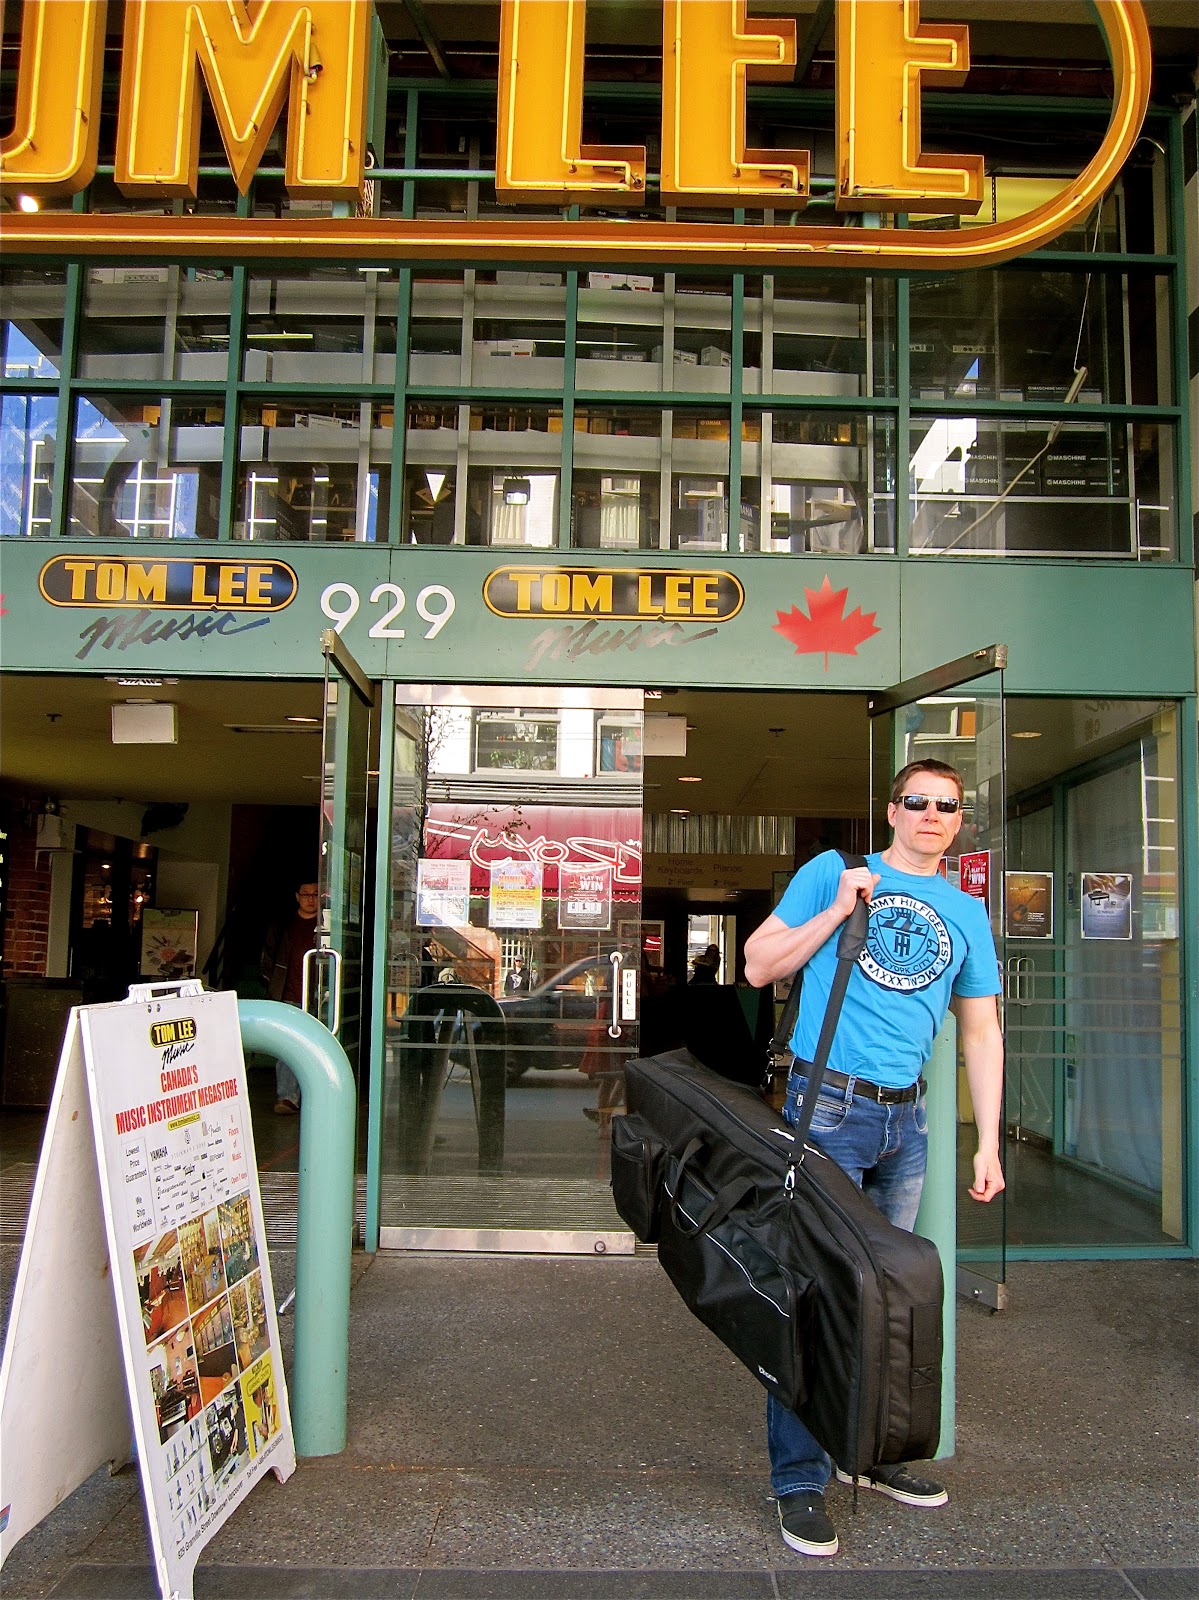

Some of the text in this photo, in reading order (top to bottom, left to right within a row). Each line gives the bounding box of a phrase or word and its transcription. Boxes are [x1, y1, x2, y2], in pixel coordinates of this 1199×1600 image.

[494, 0, 988, 216] LEE
[705, 419, 721, 427] YAMAHA
[1053, 454, 1087, 462] MASCHINE
[969, 477, 998, 485] MASCHIN
[64, 562, 273, 605] TOM LEE
[508, 573, 719, 615] TOM LEE
[320, 582, 457, 640] 929
[75, 607, 271, 660] Music
[523, 619, 719, 672] Music
[579, 880, 604, 891] WIN
[971, 872, 986, 885] WIN
[900, 898, 946, 938] HILFIGER
[869, 943, 889, 965] NEW
[889, 962, 911, 974] YORK
[912, 956, 931, 972] CITY
[154, 1020, 195, 1044] TOM LEE
[161, 1042, 195, 1070] Music
[160, 1064, 199, 1093] CANADA'S
[115, 1078, 239, 1135] MUSIC INSTRUMENT MEGASTORE
[129, 1159, 140, 1169] Price
[149, 1145, 168, 1162] YAMAHA
[125, 1169, 148, 1183] Guaranteed
[132, 1217, 153, 1233] Worldwide
[136, 1207, 146, 1218] Ship
